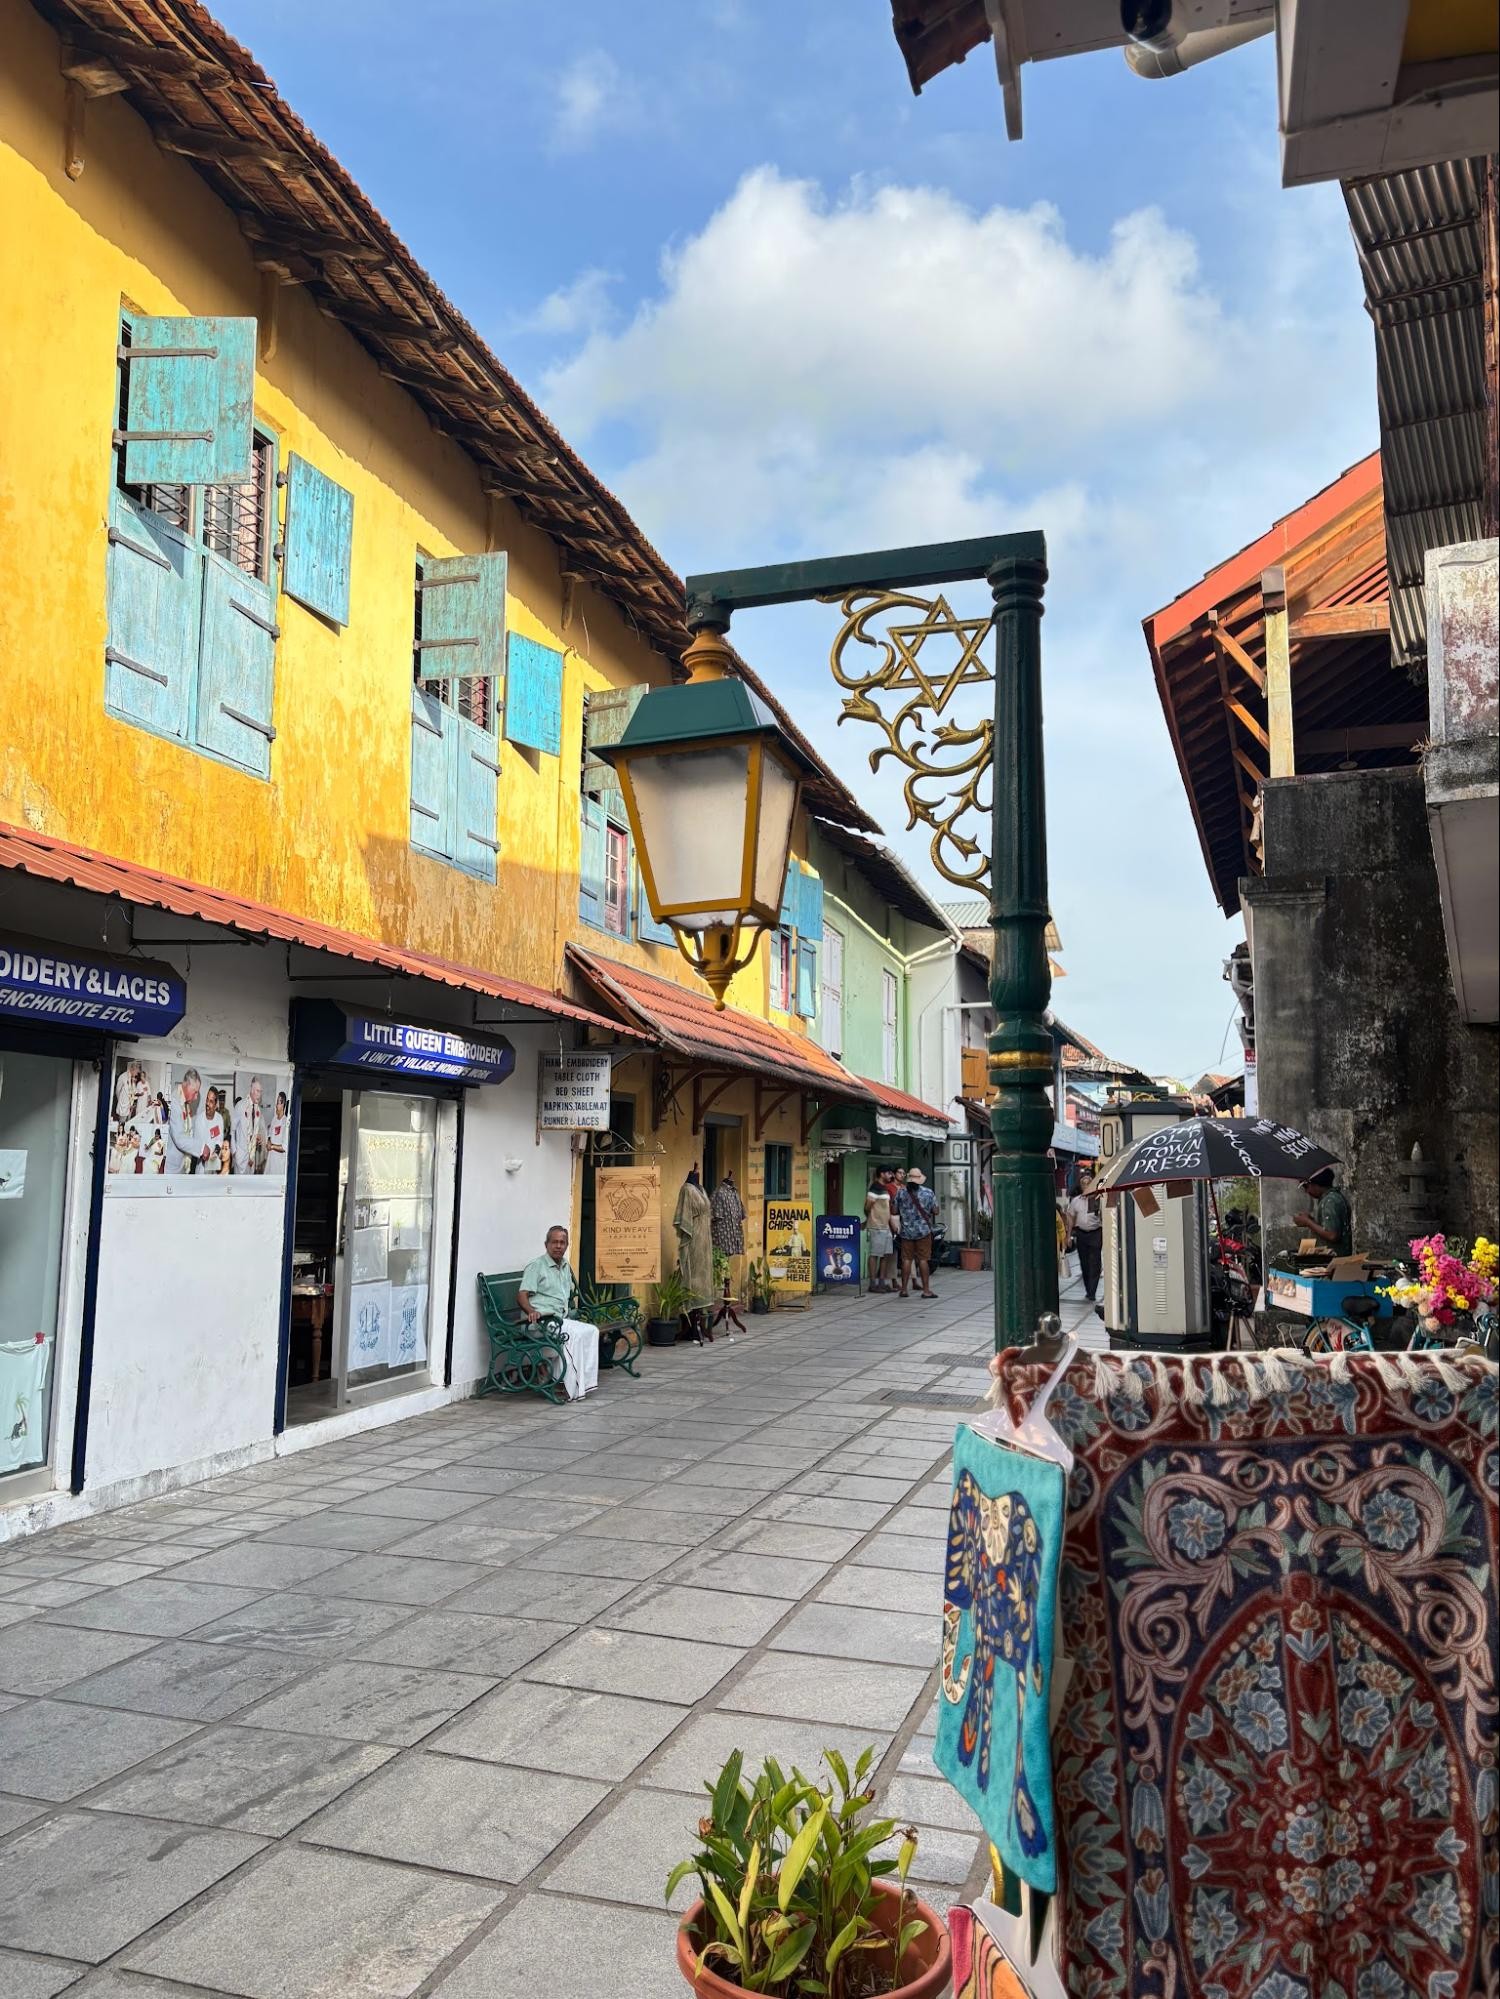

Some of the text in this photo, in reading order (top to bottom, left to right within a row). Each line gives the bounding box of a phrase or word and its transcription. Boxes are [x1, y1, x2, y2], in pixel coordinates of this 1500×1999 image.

[364, 1022, 503, 1065] LITTLE QUEEN EMBROIDERY
[358, 1051, 367, 1062] A
[369, 1051, 392, 1065] UNIT
[391, 1054, 404, 1067] OF
[402, 1055, 438, 1073] VILLAGE
[566, 1057, 609, 1068] EMBROIDERY
[554, 1072, 600, 1082] TABLE CLOTH
[555, 1086, 594, 1097] BED SHEET
[543, 1116, 569, 1126] RUNNER
[577, 1116, 600, 1126] LACES
[1140, 1136, 1204, 1159] TOWN
[1130, 1152, 1203, 1176] PRESS
[769, 1208, 811, 1221] BANANA
[768, 1220, 793, 1231] CHIPS
[822, 1222, 854, 1235] Amul
[786, 1273, 810, 1283] HERE
